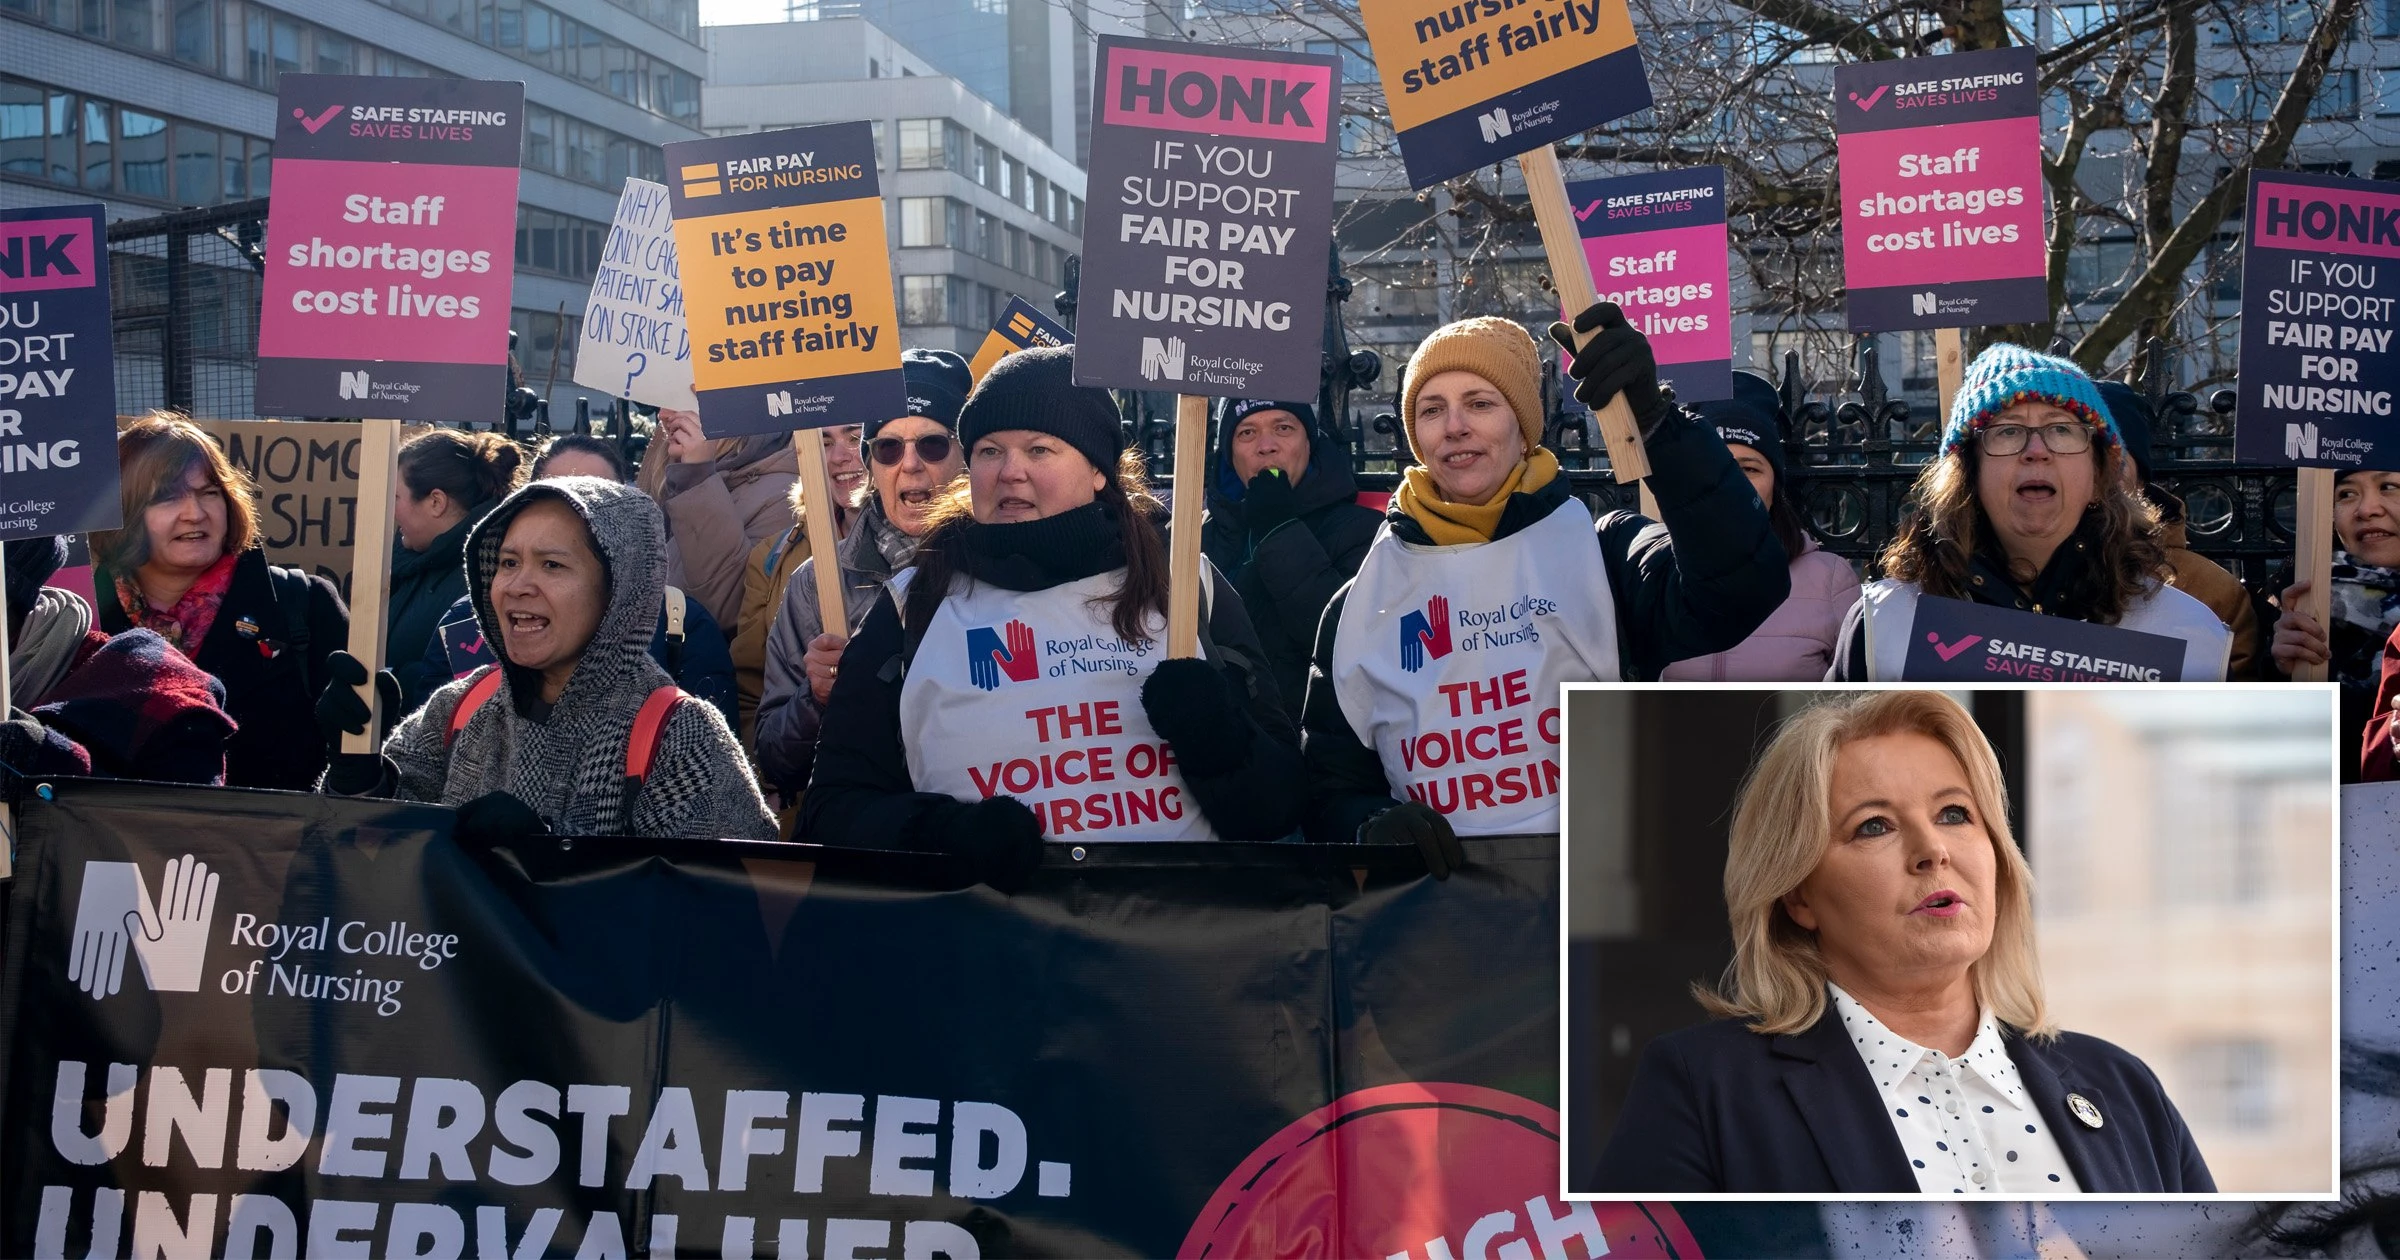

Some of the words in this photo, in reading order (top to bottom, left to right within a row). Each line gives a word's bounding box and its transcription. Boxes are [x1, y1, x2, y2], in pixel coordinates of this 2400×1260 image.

[1402, 33, 1490, 94] staff
[1497, 0, 1601, 57] fairly
[1120, 65, 1316, 128] HONK
[1894, 80, 1938, 96] SAFE
[1941, 72, 2024, 92] STAFFING
[1896, 94, 1947, 109] SAVES
[1952, 89, 1998, 104] LIVES
[351, 105, 404, 122] SAFE
[408, 108, 507, 126] STAFFING
[1512, 108, 1533, 123] Royal
[1533, 100, 1560, 114] College
[1515, 122, 1523, 132] of
[1524, 114, 1553, 129] Nursing
[350, 123, 413, 139] SAVES
[419, 125, 473, 141] LIVES
[726, 158, 773, 176] FAIR
[776, 151, 815, 169] PAY
[1153, 140, 1184, 170] IF
[1194, 144, 1273, 178] YOU
[1898, 147, 1980, 178] Staff
[729, 177, 769, 193] FOR
[773, 164, 862, 188] NURSING
[343, 193, 445, 226] Staff
[619, 182, 668, 228] WHY
[1121, 176, 1300, 218] SUPPORT
[1607, 195, 1643, 209] SAFE
[1645, 187, 1714, 205] STAFFING
[1607, 206, 1650, 220] SAVES
[1653, 201, 1692, 215] LIVES
[1859, 186, 2024, 218] shortages
[768, 220, 847, 250] time
[1120, 213, 1210, 250] FAIR
[1219, 222, 1296, 256] PAY
[1866, 226, 1936, 253] cost
[1942, 221, 2019, 247] lives
[2266, 197, 2400, 247] HONK
[288, 237, 491, 279] shortages
[604, 224, 645, 268] ONLY
[731, 266, 767, 289] to
[775, 259, 835, 290] pay
[1165, 255, 1245, 290] FOR
[1609, 250, 1677, 277] Staff
[2290, 259, 2313, 284] IF
[2320, 261, 2376, 289] YOU
[292, 287, 378, 315] cost
[387, 284, 481, 319] lives
[593, 265, 657, 307] PATIENT
[1597, 282, 1713, 307] ortages
[725, 290, 852, 326] nursing
[1112, 289, 1292, 331] NURSING
[2267, 289, 2396, 322] SUPPORT
[588, 303, 615, 343] ON
[616, 311, 673, 355] STRIKE
[674, 328, 691, 361] D
[1644, 312, 1709, 336] lives
[2267, 320, 2334, 349] FAIR
[2340, 326, 2394, 353] PAY
[708, 329, 785, 363] staff
[791, 321, 879, 353] fairly
[624, 352, 647, 398] ?
[1189, 371, 1202, 383] of
[1203, 371, 1246, 389] Nursing
[1190, 355, 1221, 371] Royal
[1223, 358, 1264, 376] College
[2301, 354, 2359, 383] FOR
[371, 391, 380, 399] of
[381, 390, 410, 403] Nursing
[372, 382, 393, 391] Royal
[393, 382, 421, 393] College
[794, 397, 811, 405] Royal
[812, 395, 835, 404] College
[2263, 384, 2392, 416] NURSING
[803, 404, 828, 413] Nursing
[0, 439, 81, 473] ING
[2321, 437, 2344, 451] Royal
[2344, 438, 2374, 452] College
[2321, 450, 2330, 459] of
[2331, 450, 2362, 465] Nursing
[9, 500, 56, 514] College
[1458, 604, 1505, 632] Royal
[1510, 594, 1558, 619] College
[1046, 634, 1092, 659] Royal
[1462, 633, 1480, 652] of
[1484, 621, 1540, 649] Nursing
[1049, 658, 1067, 678] of
[1072, 655, 1139, 676] Nursing
[1984, 655, 2055, 682] SAVES
[1987, 638, 2045, 663] SAFE
[2049, 649, 2161, 682] STAFFING
[1438, 668, 1532, 718] THE
[1025, 700, 1123, 743] THE
[1401, 717, 1529, 772] VOICE
[967, 746, 1116, 800] VOICE
[1125, 743, 1180, 779] OF
[230, 913, 330, 961] Royal
[337, 921, 459, 970] College
[220, 960, 264, 995] of
[267, 963, 405, 1017] Nursing
[51, 1060, 1072, 1200] UNDERSTAFFED.
